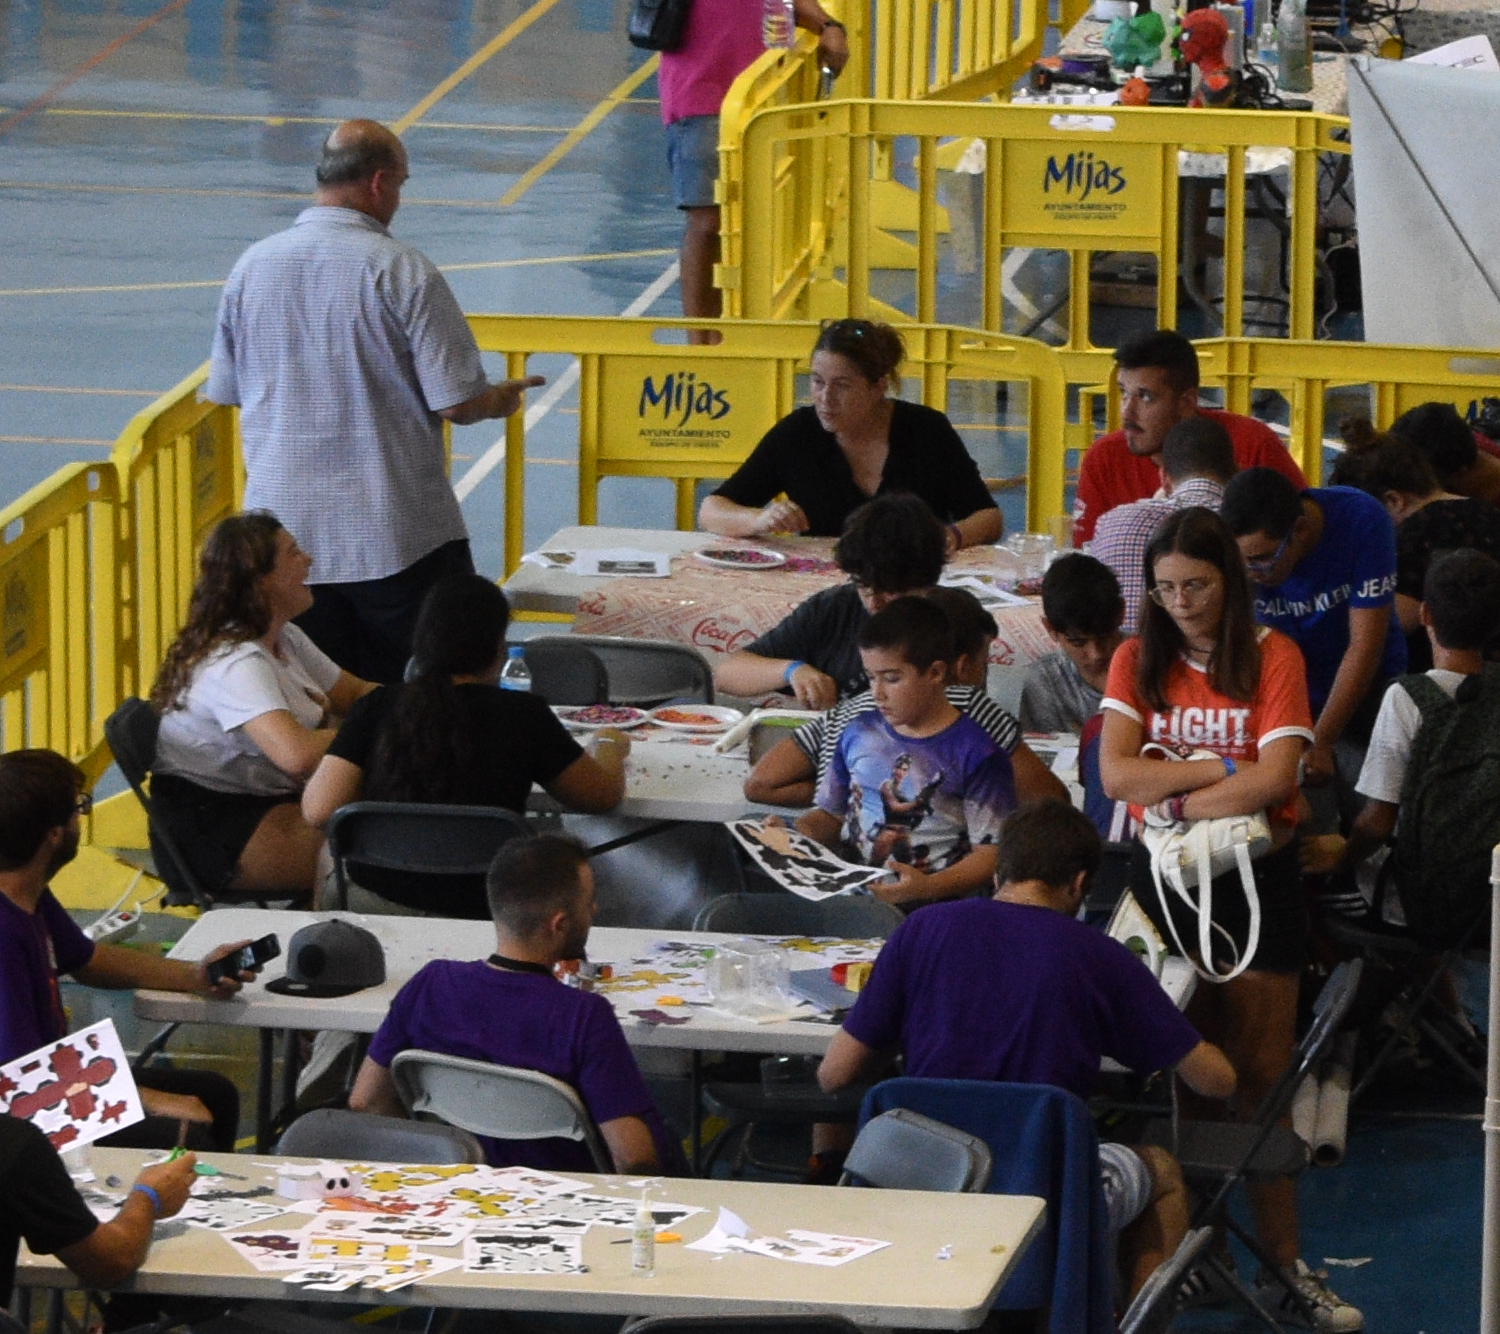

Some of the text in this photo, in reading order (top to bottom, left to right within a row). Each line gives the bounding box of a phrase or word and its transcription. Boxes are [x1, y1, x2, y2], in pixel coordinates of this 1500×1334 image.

[1043, 150, 1127, 202] Mijas
[638, 371, 732, 428] Mijas
[1151, 705, 1252, 746] FIGHT
